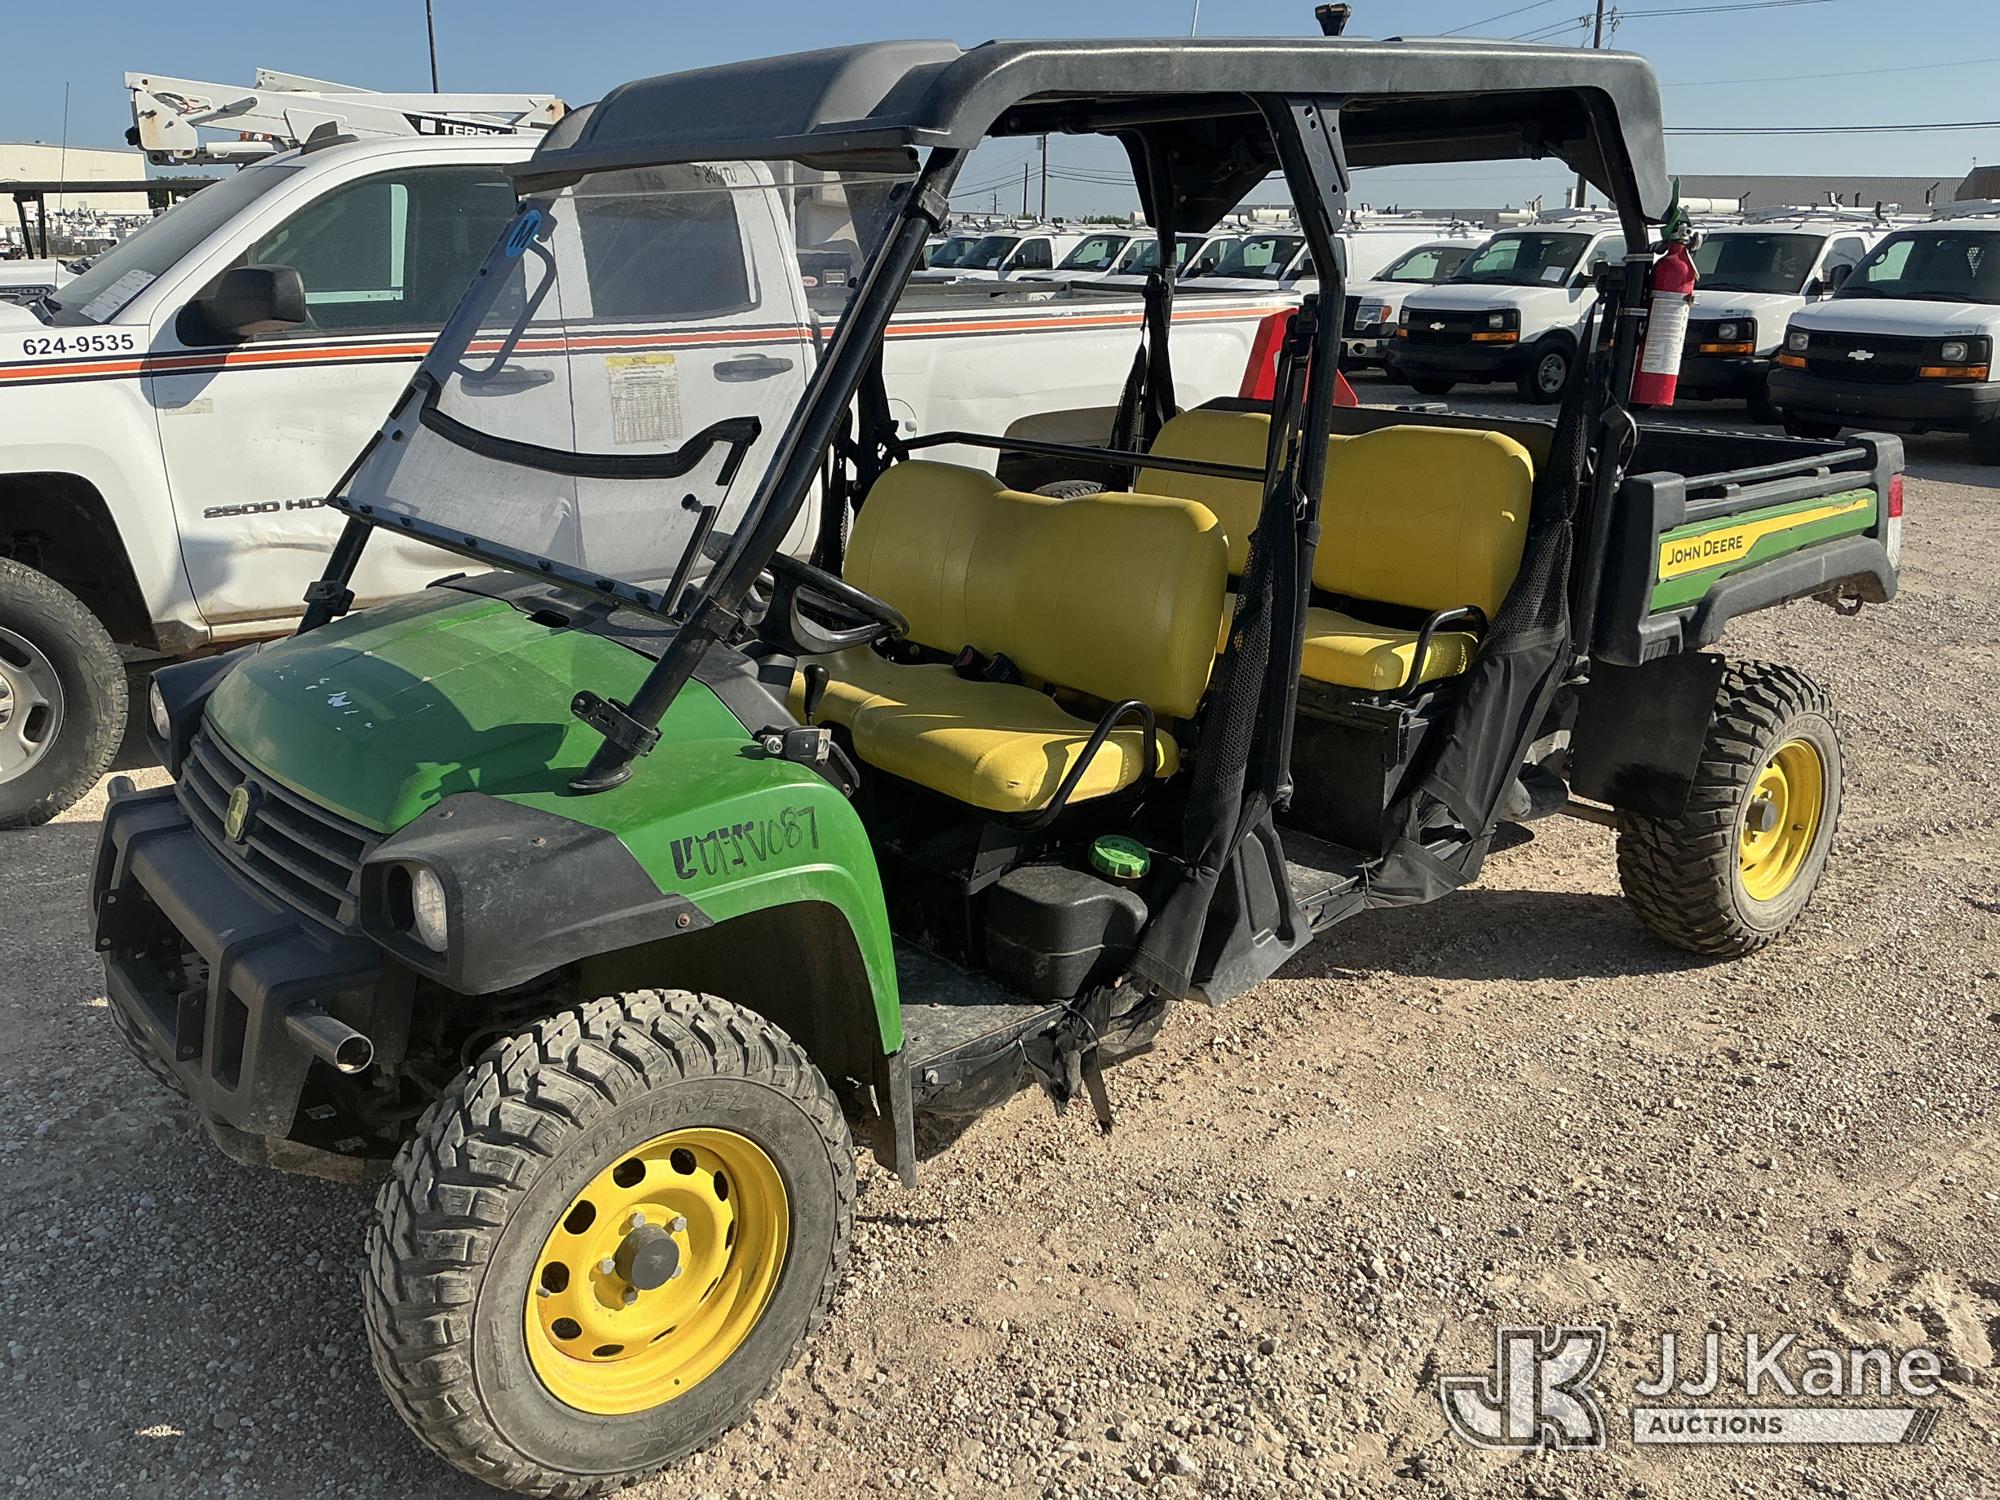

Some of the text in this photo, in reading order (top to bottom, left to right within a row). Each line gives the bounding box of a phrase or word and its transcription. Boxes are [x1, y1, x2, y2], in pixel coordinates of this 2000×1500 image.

[23, 333, 134, 356] 624-9535
[203, 496, 325, 518] 2500 HD
[1667, 535, 1744, 566] JOHN DEERE
